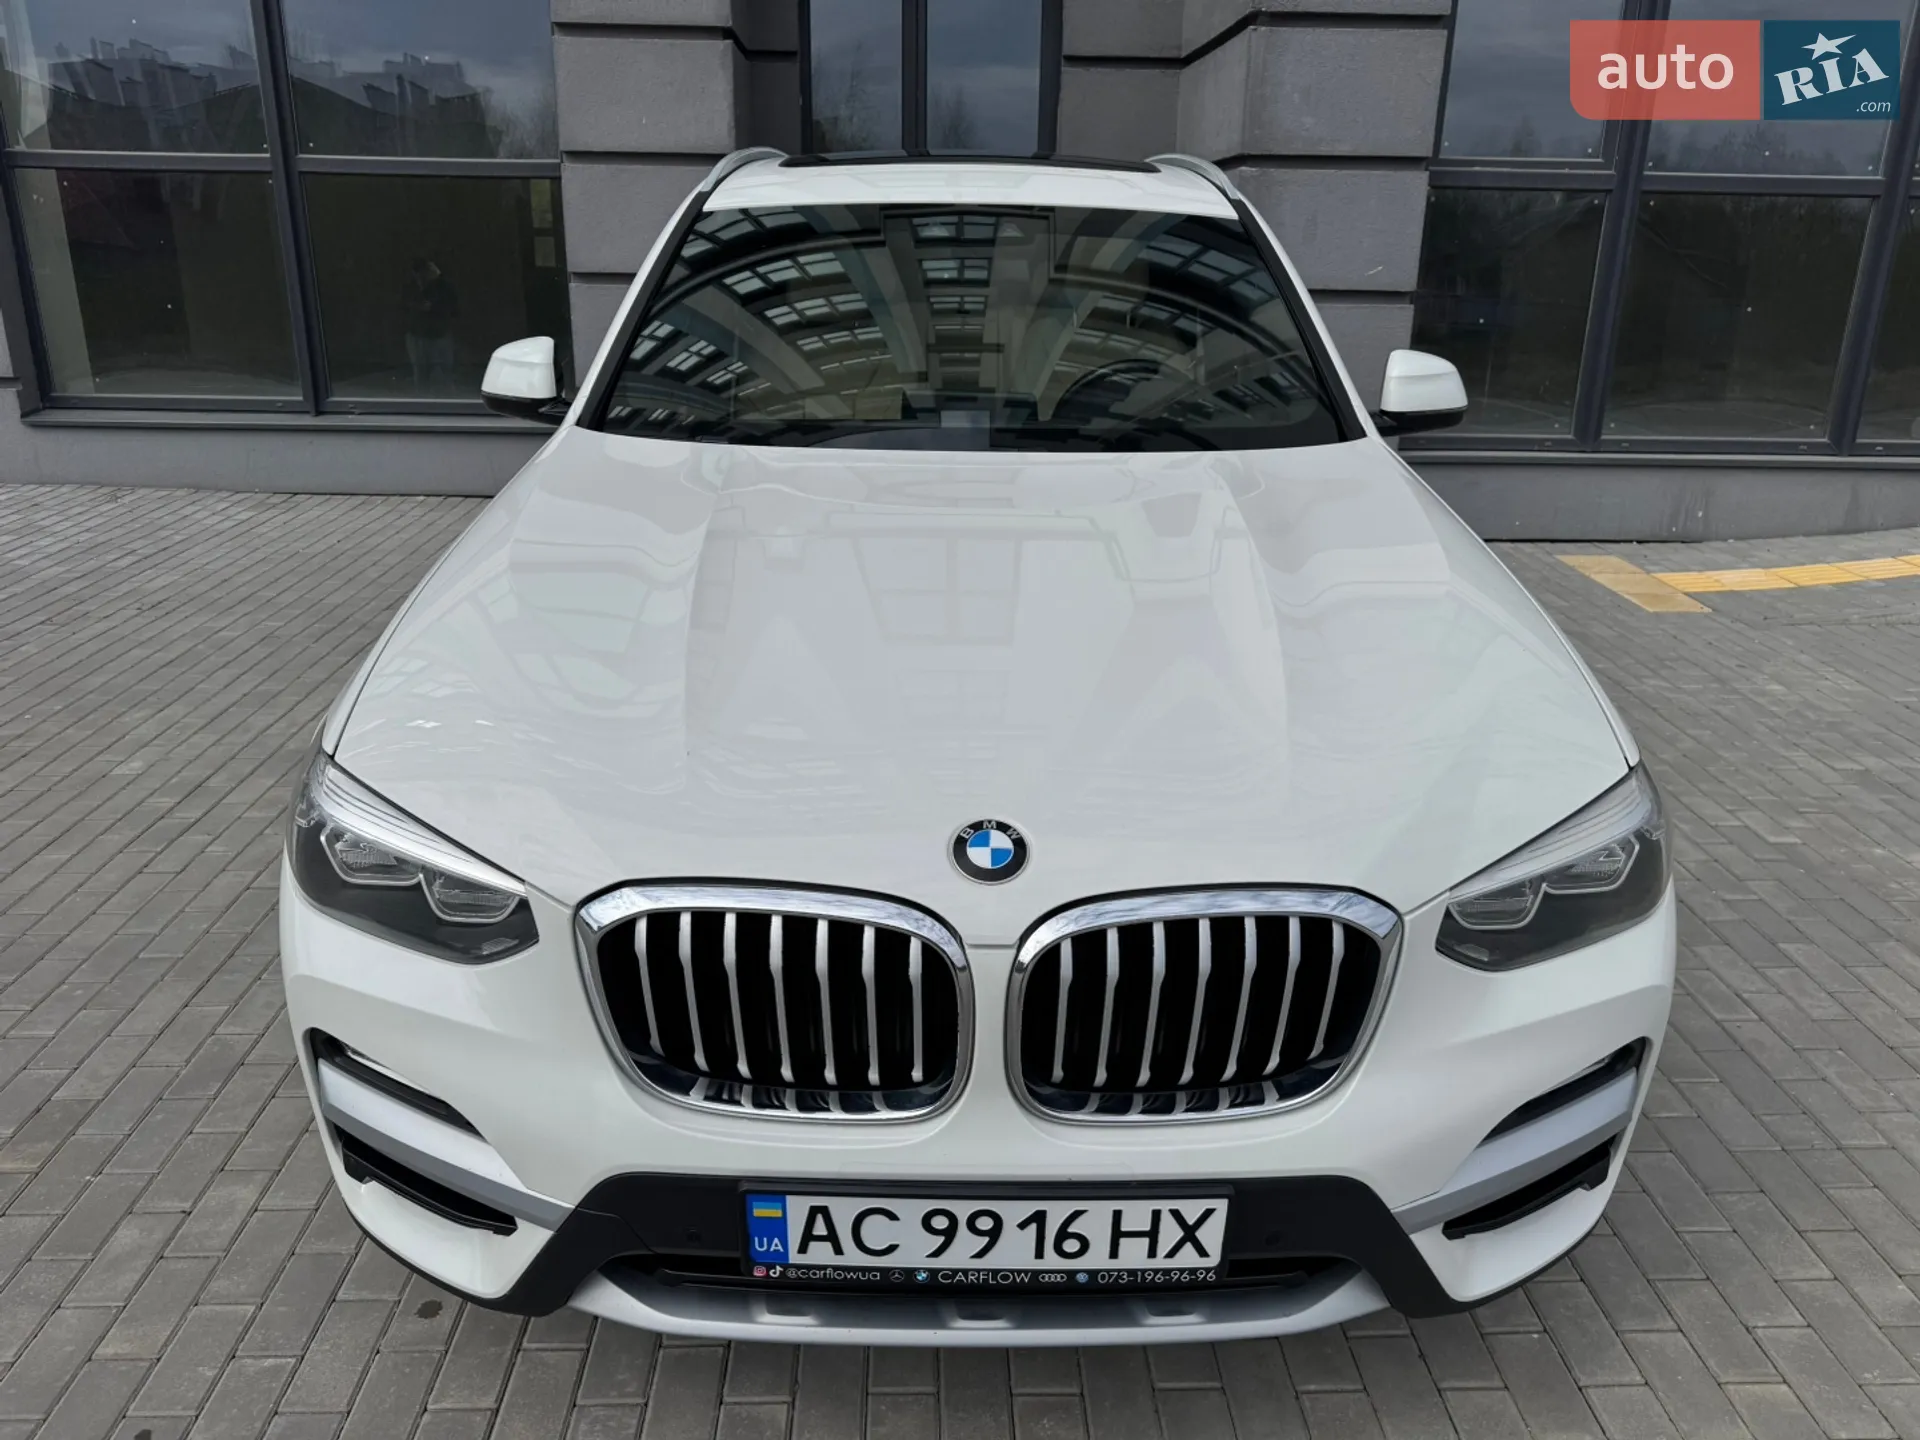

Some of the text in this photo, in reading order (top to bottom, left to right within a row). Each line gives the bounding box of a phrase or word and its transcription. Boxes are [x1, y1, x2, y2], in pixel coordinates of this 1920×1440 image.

[960, 820, 1022, 839] BMW
[796, 1205, 1218, 1260] AC 9916 HX
[754, 1236, 785, 1253] UA
[785, 1267, 1217, 1284] @carflowua CARFLOW 073-196-96-96
